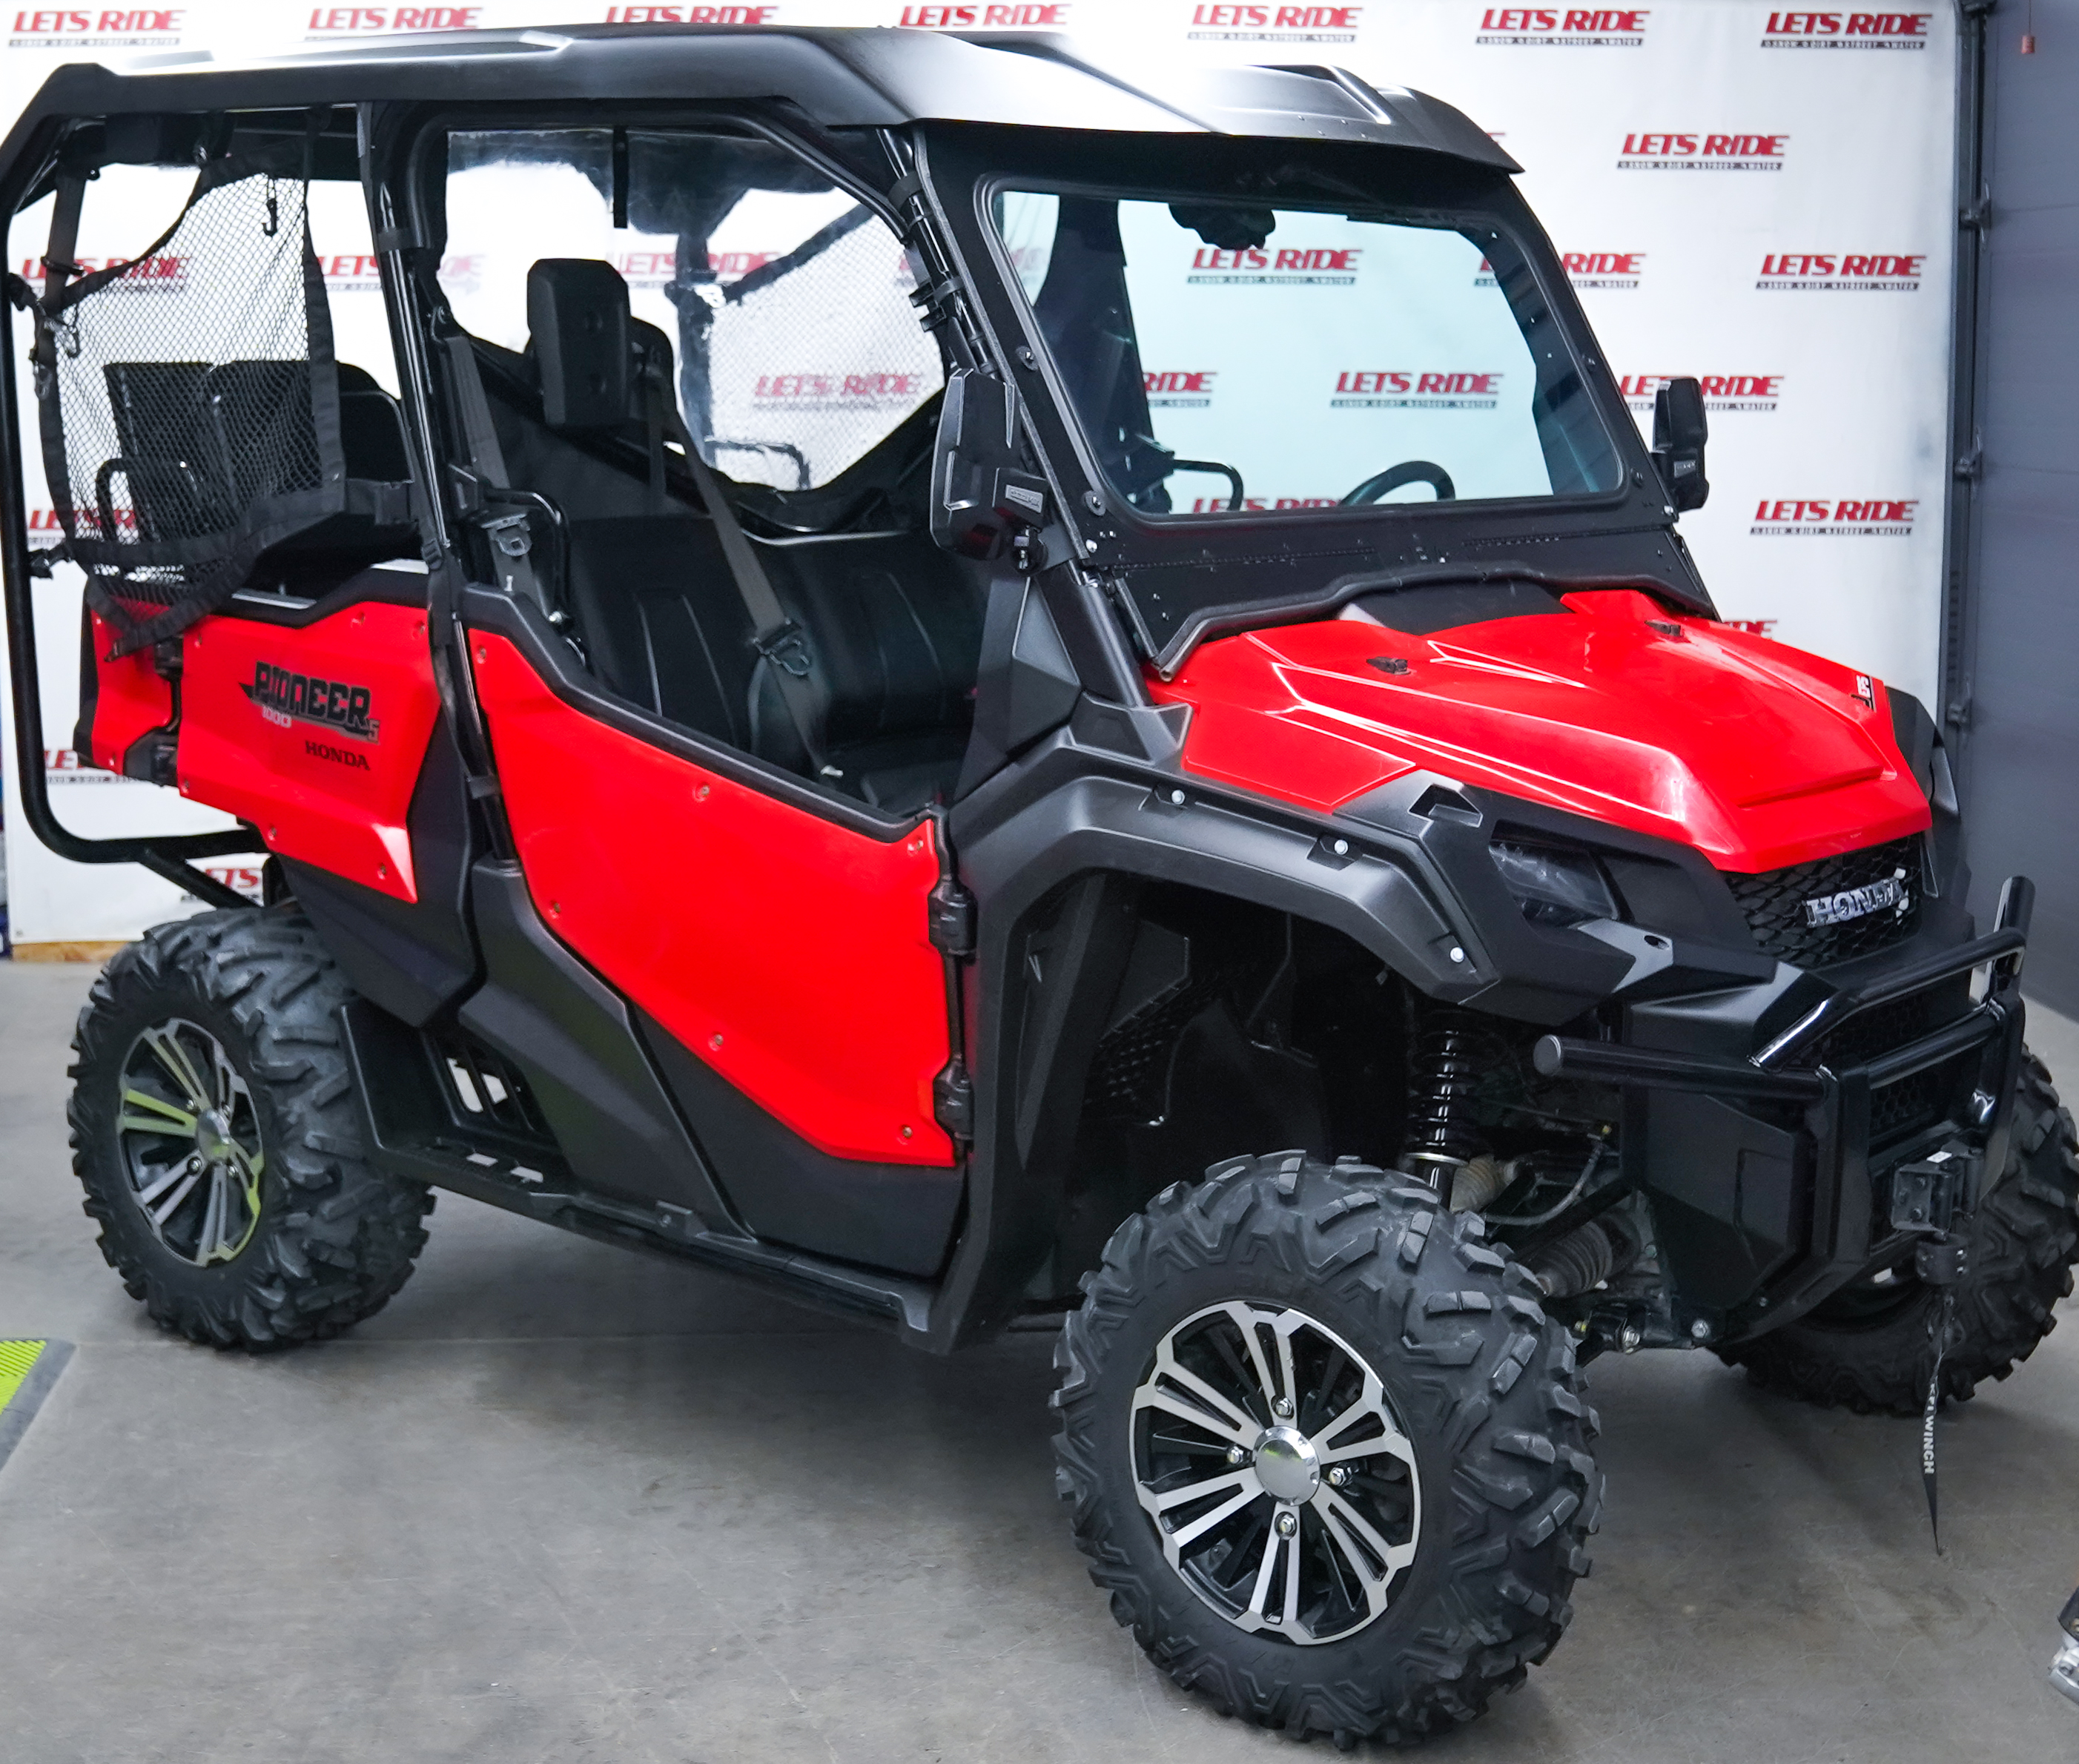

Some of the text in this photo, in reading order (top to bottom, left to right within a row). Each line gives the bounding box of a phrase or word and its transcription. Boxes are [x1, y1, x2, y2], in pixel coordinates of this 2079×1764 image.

[13, 10, 186, 32] LETS RIDE
[309, 7, 482, 30] LETS RIDE
[899, 4, 1072, 27] LETS RIDE
[1192, 4, 1363, 28] LETS RIDE
[1481, 9, 1650, 32] LETS RIDE
[1765, 12, 1932, 36] LETS RIDE
[1622, 133, 1789, 156] LETS RIDE
[1192, 248, 1361, 270] LETS RIDE
[1562, 253, 1646, 274] RIDE
[1760, 254, 1926, 277] LETS RIDE
[1336, 372, 1503, 394] LETS RIDE
[1702, 376, 1785, 397] RIDE
[1755, 501, 1919, 522] LETS RIDE
[305, 739, 371, 771] HONDA
[1923, 1415, 1936, 1475] WINCH
